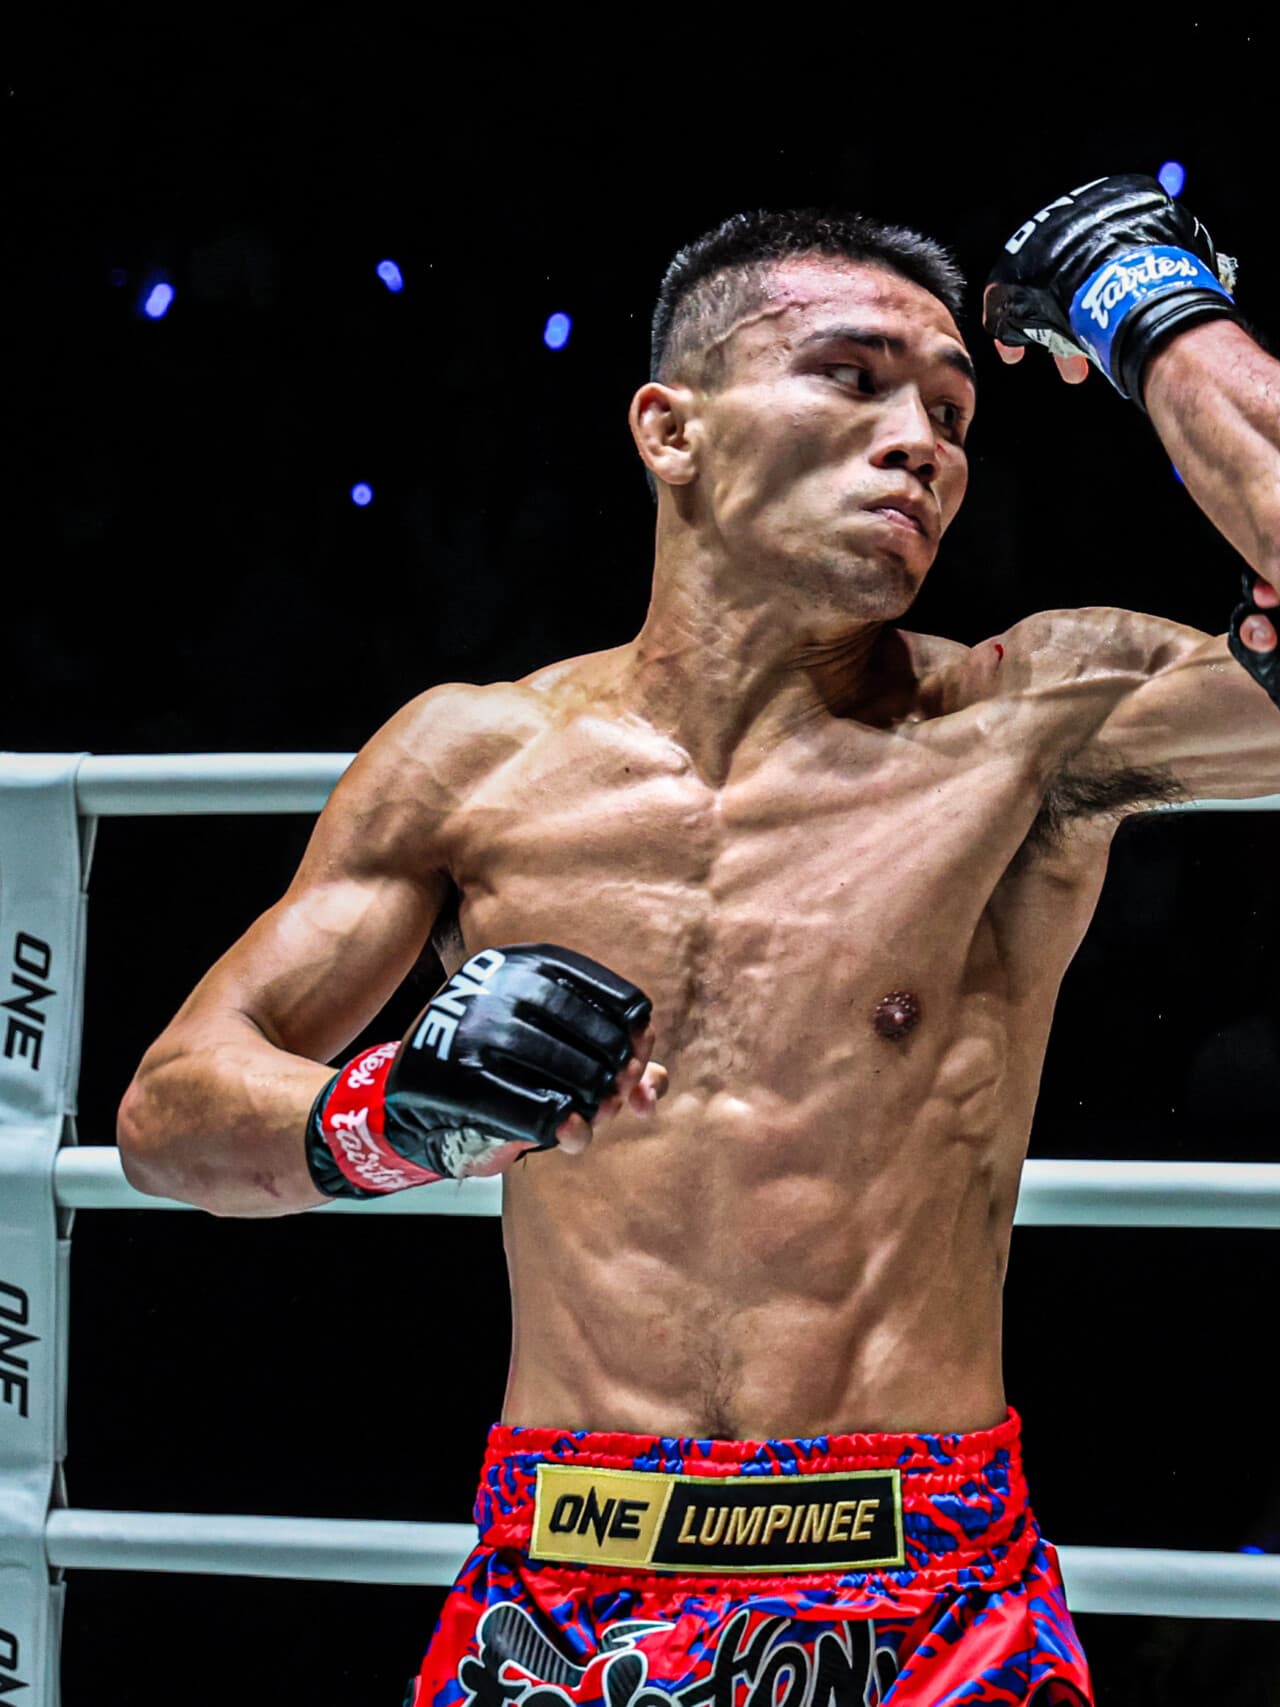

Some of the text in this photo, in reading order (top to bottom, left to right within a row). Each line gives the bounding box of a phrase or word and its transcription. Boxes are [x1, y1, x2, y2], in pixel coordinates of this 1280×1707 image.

[0, 931, 57, 1071] ONE
[412, 949, 506, 1061] ONE
[549, 1486, 880, 1547] ONE LUMPINEE
